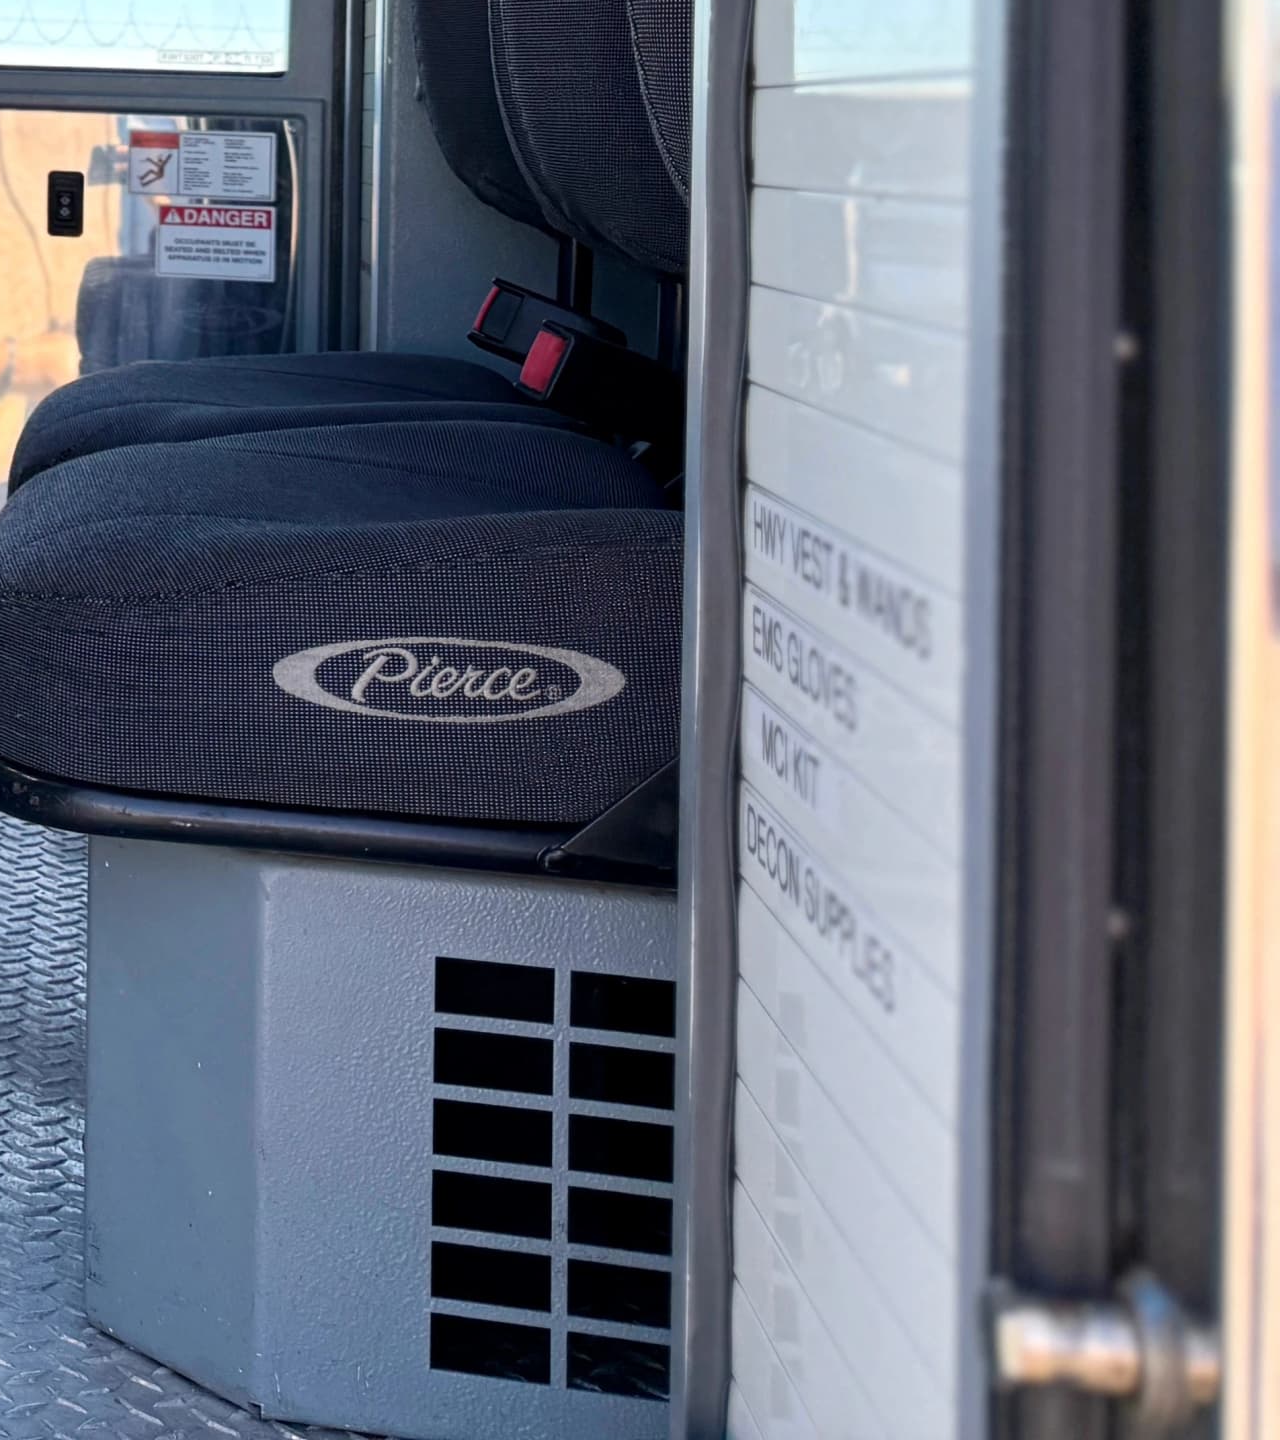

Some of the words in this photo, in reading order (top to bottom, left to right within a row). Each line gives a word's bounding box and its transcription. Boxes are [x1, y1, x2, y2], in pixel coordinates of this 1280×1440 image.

[183, 208, 268, 227] DANGER
[753, 501, 787, 565] HWY
[790, 522, 833, 596] VEST
[351, 647, 541, 703] Pierce
[752, 604, 784, 674] EMS
[787, 632, 858, 733] GLOVES
[762, 711, 789, 782] MCI
[793, 742, 820, 810] KIT
[747, 803, 801, 909] DECON
